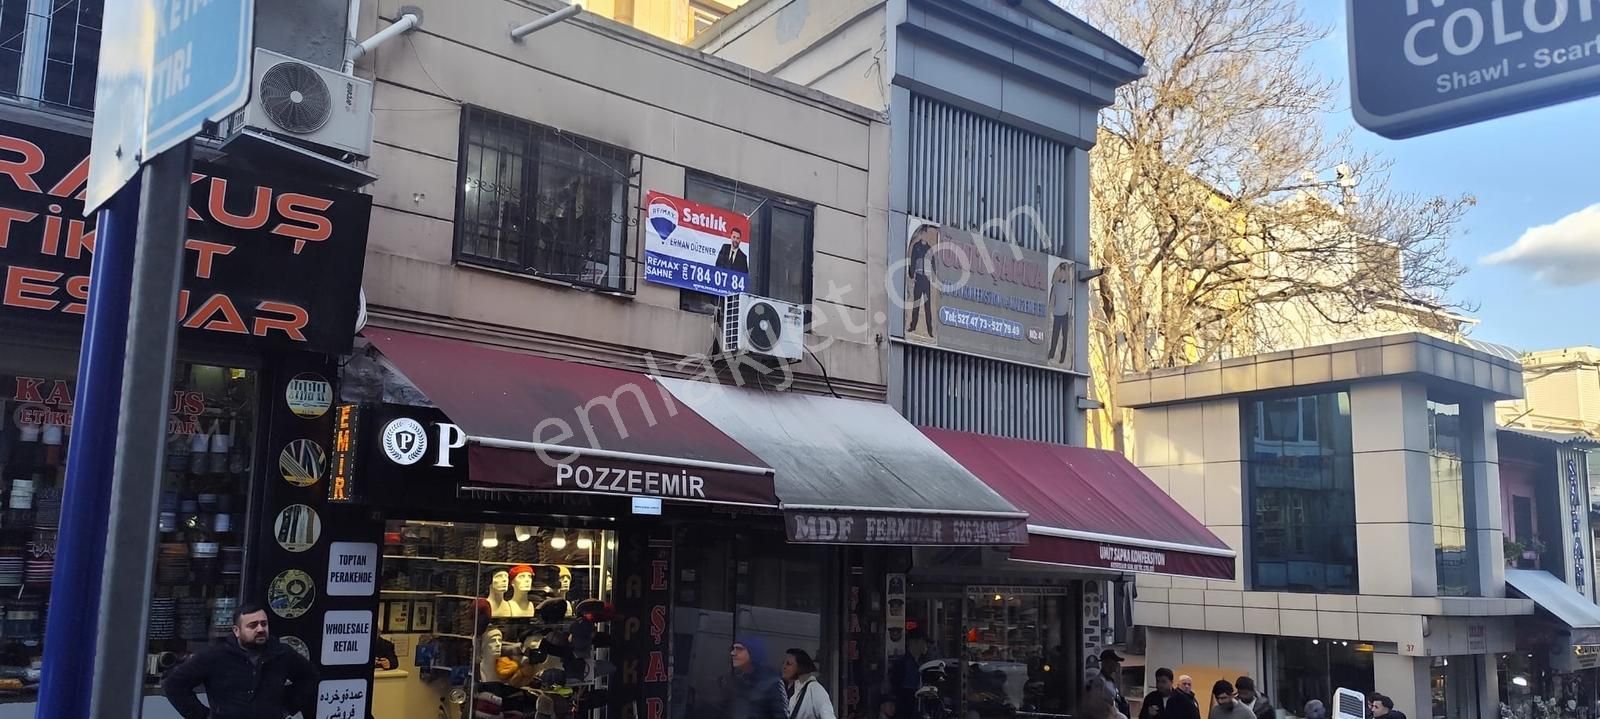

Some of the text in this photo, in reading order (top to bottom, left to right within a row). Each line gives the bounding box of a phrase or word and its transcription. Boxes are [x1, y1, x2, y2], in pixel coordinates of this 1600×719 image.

[1436, 58, 1509, 93] Shawl
[682, 207, 727, 233] Satılık
[669, 238, 717, 257] ERMAN DÜZENER
[647, 256, 679, 271] RE/MAX
[646, 265, 673, 280] SAHNE
[690, 265, 711, 284] 784
[714, 270, 728, 288] 07
[731, 274, 745, 291] 84
[399, 433, 413, 450] P
[556, 463, 705, 498] POZZEEMİR
[794, 515, 854, 542] MDF
[865, 517, 942, 543] FERMUAR
[339, 554, 367, 566] TOPTAN
[330, 571, 373, 583] PERAKENDE
[326, 622, 369, 635] WHOLESALE
[333, 640, 358, 653] RETAIL
[1406, 644, 1414, 652] 37
